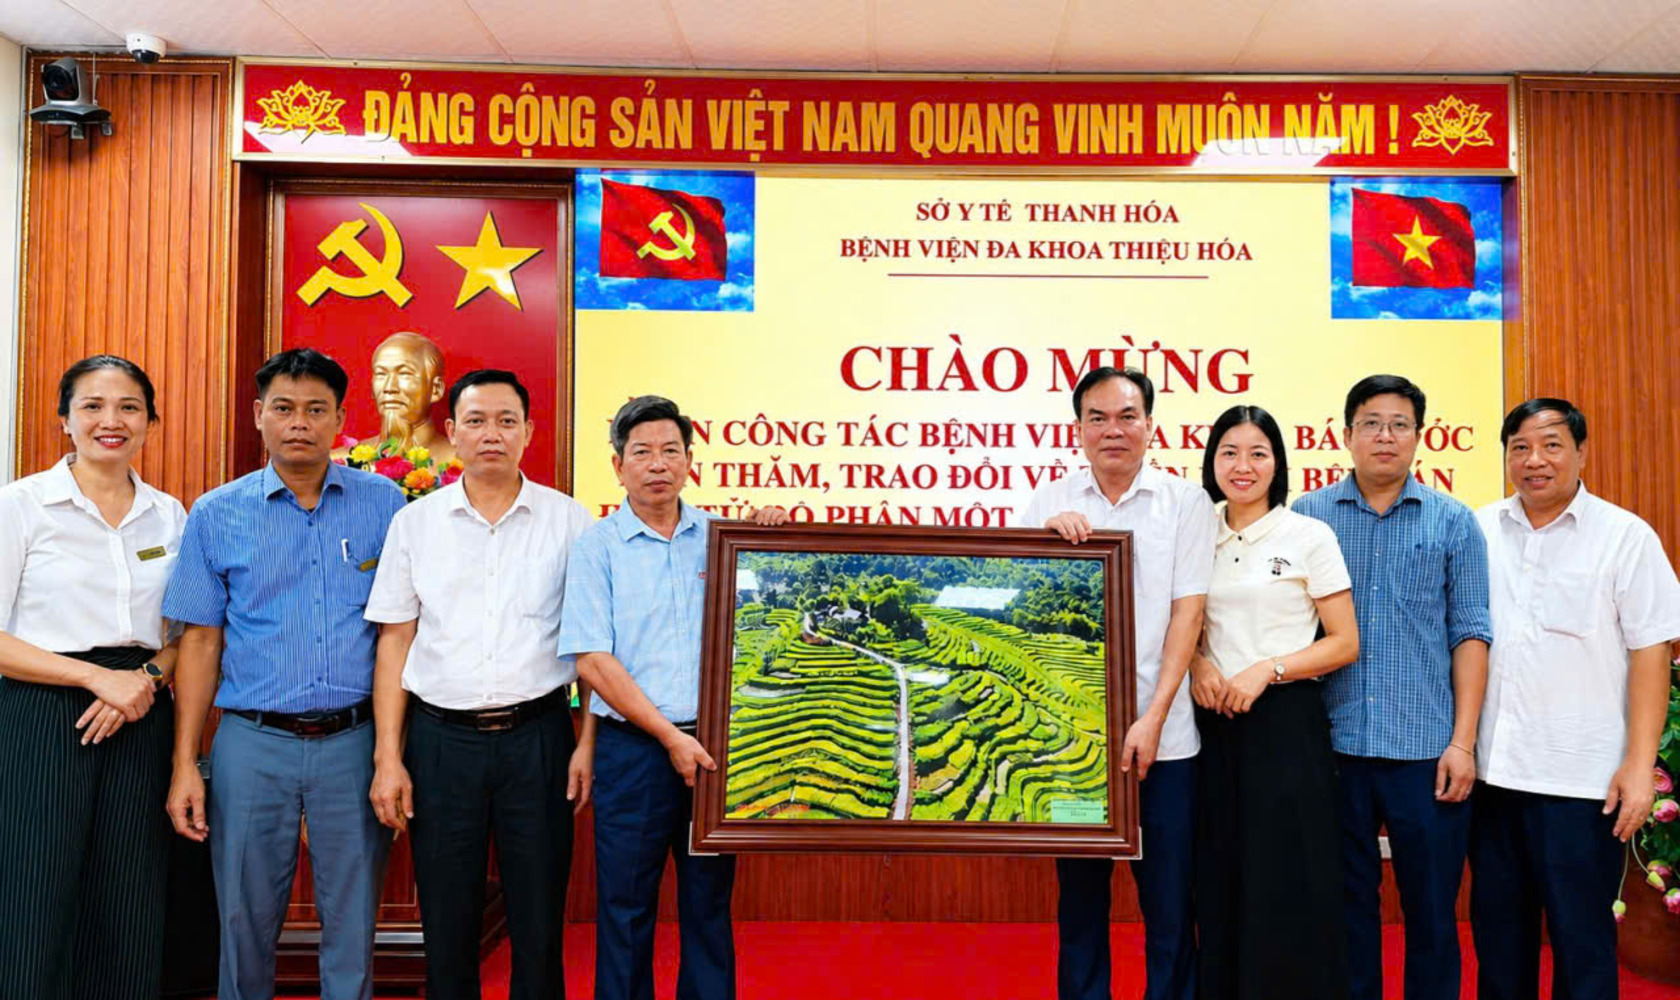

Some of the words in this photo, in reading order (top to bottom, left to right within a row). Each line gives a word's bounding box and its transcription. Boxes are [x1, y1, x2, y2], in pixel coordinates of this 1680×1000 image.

[363, 73, 475, 145] ĐẢNG
[489, 82, 596, 157] CỘNG
[609, 79, 693, 149] SẢN
[706, 89, 790, 162] VIỆT
[802, 101, 896, 153] NAM
[909, 102, 1040, 159] QUANG
[1053, 104, 1143, 154] VINH
[1157, 92, 1270, 156] MUÔN
[1283, 92, 1374, 156] NĂM
[916, 197, 951, 221] SỞ
[958, 203, 974, 221] Y
[1025, 203, 1116, 223] THANH
[1124, 200, 1180, 224] HÓA
[840, 236, 911, 263] BỆNH
[917, 236, 980, 263] VIỆN
[986, 240, 1022, 259] ĐA
[1028, 241, 1104, 260] KHOA
[1109, 239, 1190, 265] THIỆU
[1197, 238, 1254, 261] HÓA
[840, 334, 1029, 393] CHÀO
[1046, 335, 1255, 394] MỪNG
[722, 412, 826, 447] CÔNG
[837, 414, 909, 447] TÁC
[919, 418, 1015, 455] BỆNH
[1294, 417, 1341, 451] BÁ
[713, 455, 830, 494] THĂM,
[839, 464, 939, 490] TRAO
[947, 456, 1012, 490] ĐỔI
